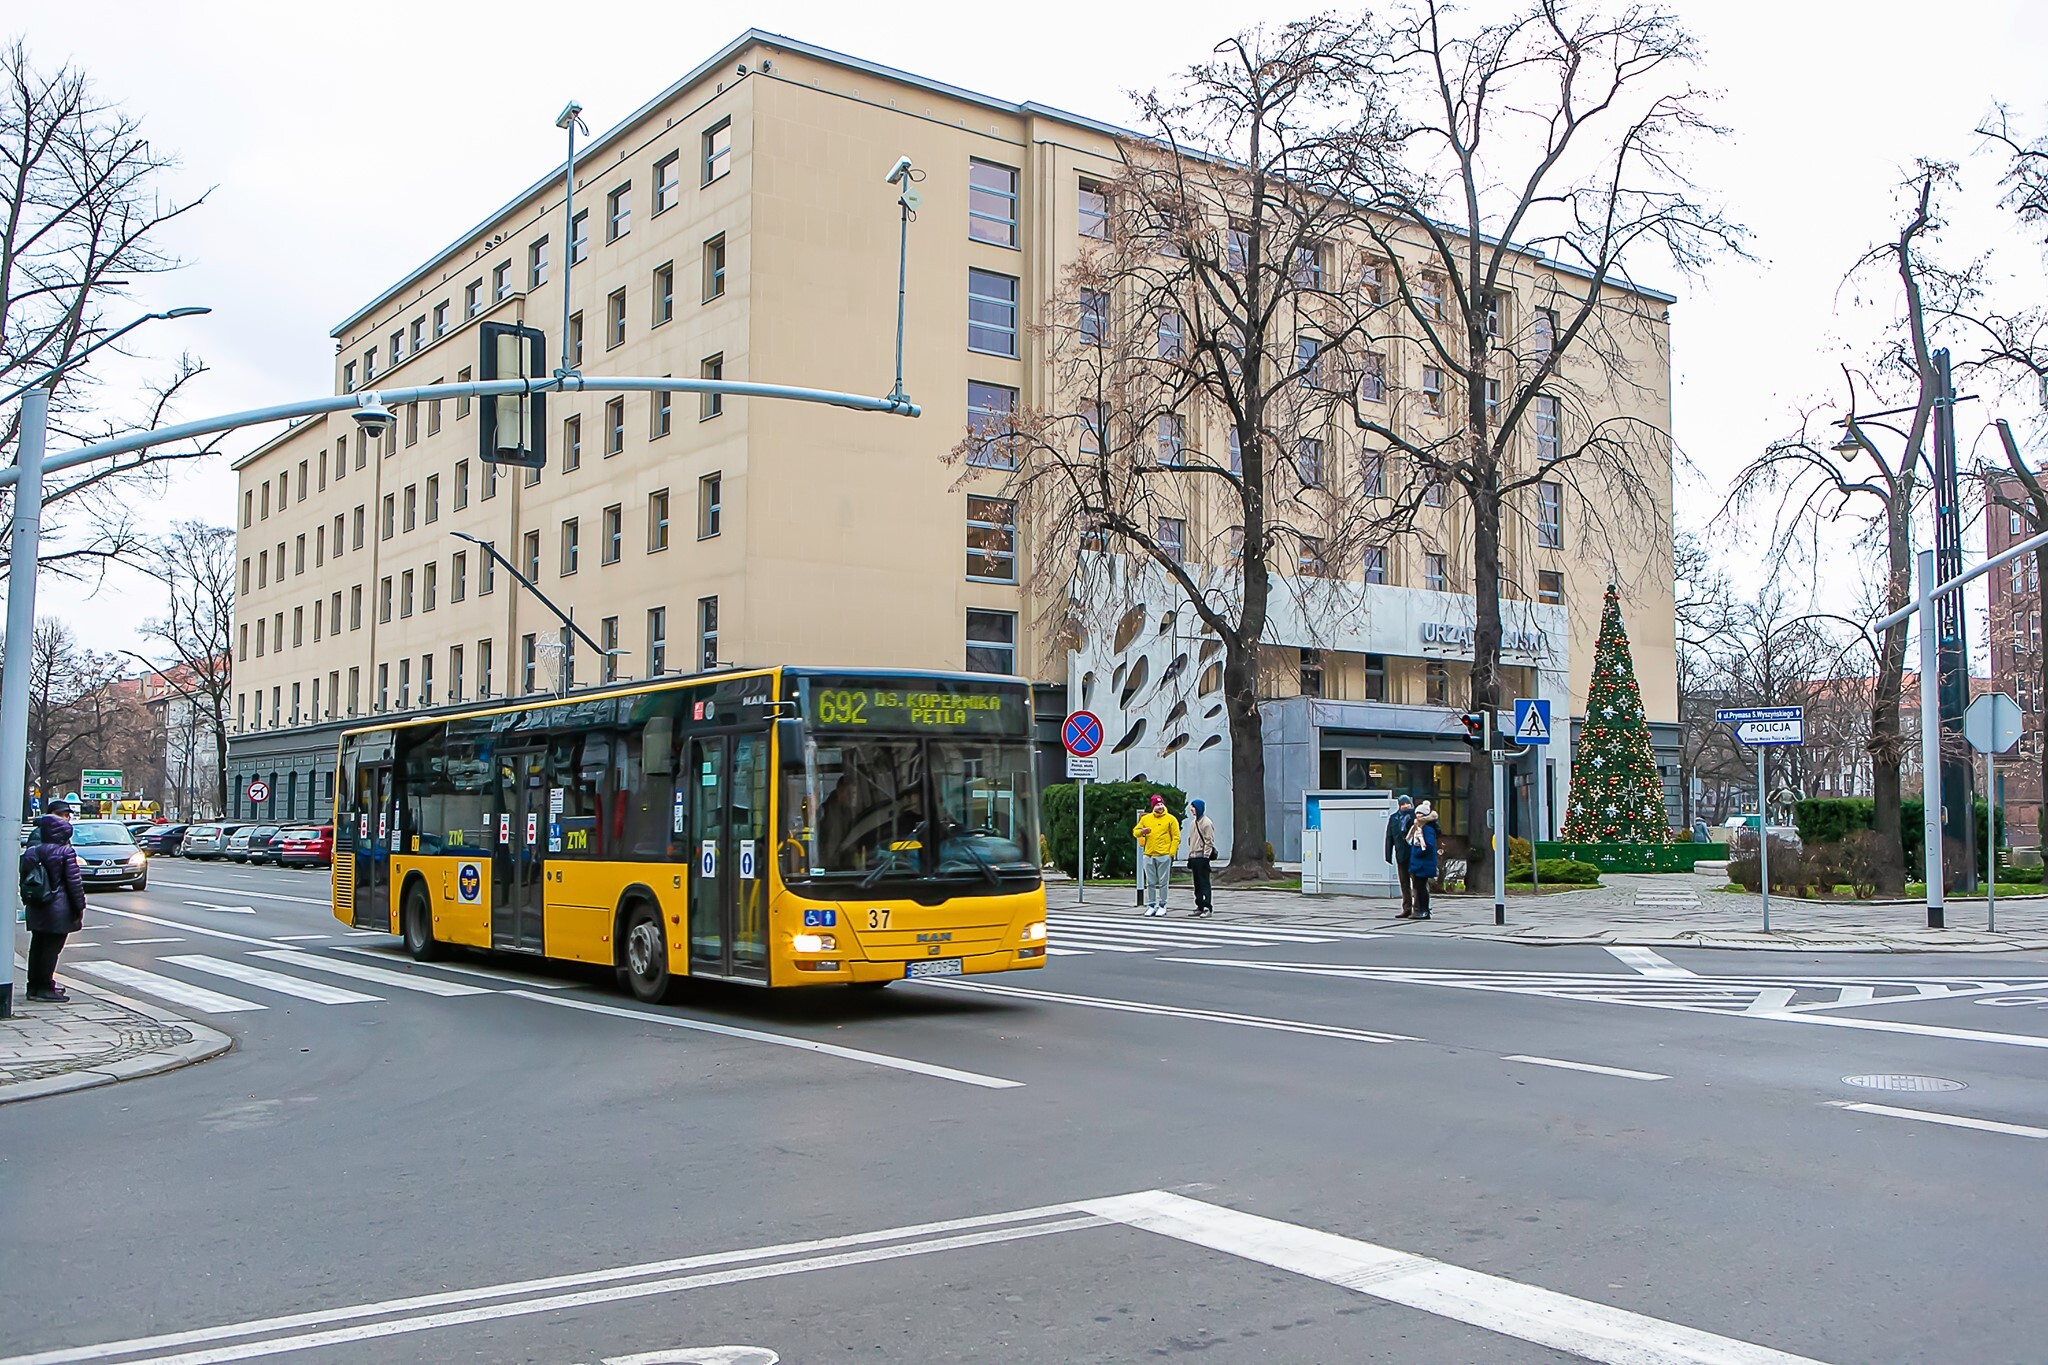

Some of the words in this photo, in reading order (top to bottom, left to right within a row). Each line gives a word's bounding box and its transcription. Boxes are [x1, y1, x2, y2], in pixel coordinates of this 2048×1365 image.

[742, 694, 767, 706] MAN
[819, 690, 868, 724] 692
[906, 693, 1001, 711] KOPERNIKA
[1750, 723, 1791, 732] POLICJA
[448, 829, 464, 846] ZTM
[566, 829, 587, 850] ZTM
[868, 909, 890, 929] 37
[917, 932, 952, 942] MAN
